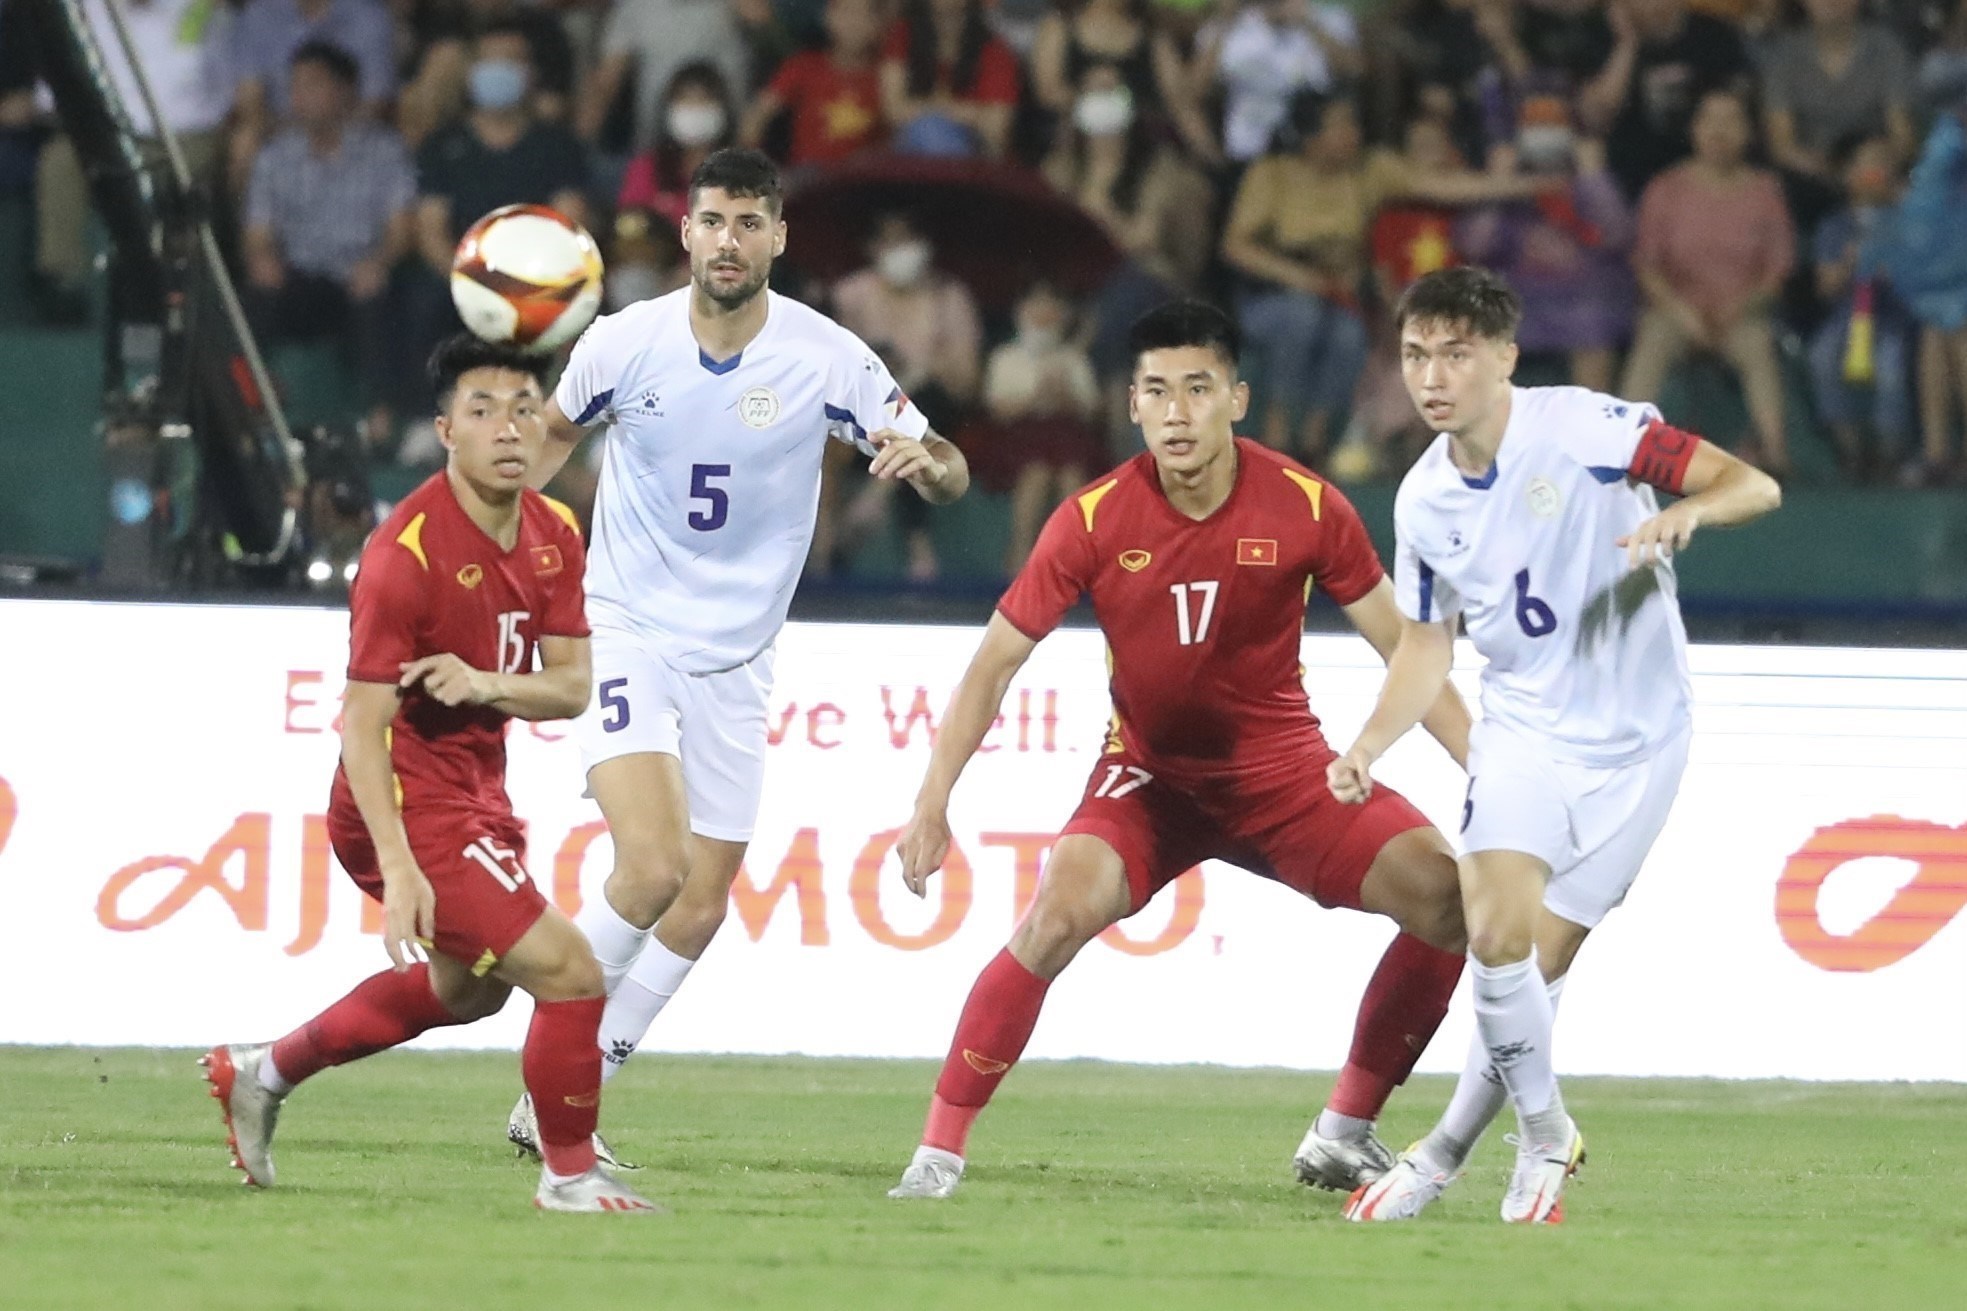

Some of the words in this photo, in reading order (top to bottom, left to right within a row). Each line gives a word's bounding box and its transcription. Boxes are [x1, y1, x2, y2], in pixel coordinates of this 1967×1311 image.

[688, 463, 731, 532] 5
[1169, 580, 1220, 646] 17
[1515, 568, 1557, 638] 6
[497, 611, 531, 674] 15
[599, 677, 631, 734] 5
[1094, 764, 1154, 799] 17
[461, 835, 527, 893] 15
